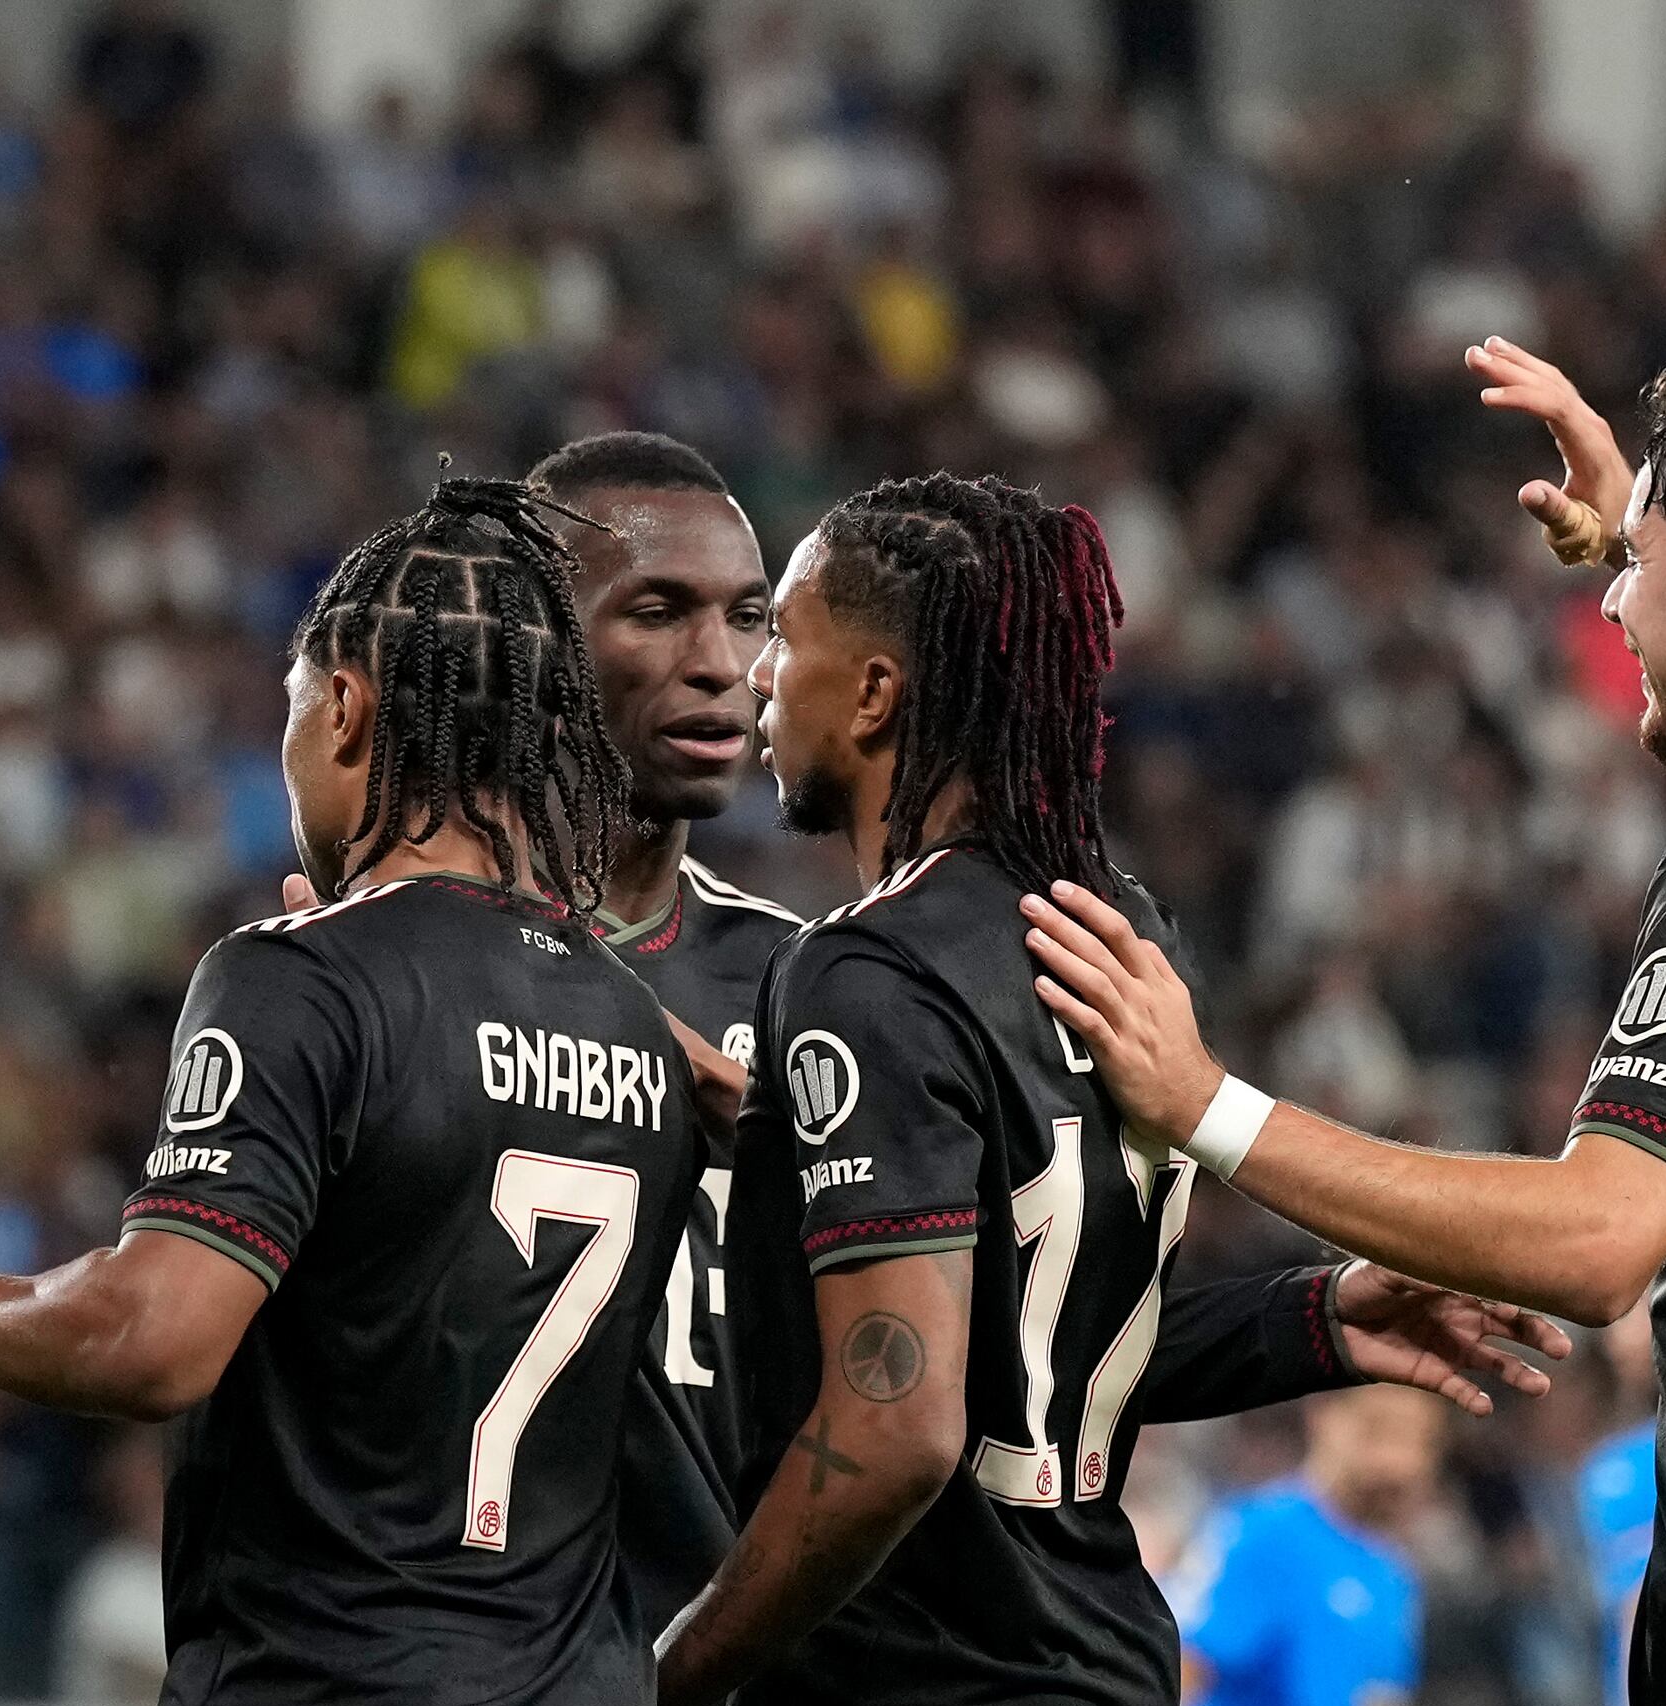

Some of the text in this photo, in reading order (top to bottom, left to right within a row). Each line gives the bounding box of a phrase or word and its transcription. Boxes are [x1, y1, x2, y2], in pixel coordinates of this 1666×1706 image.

[519, 927, 572, 956] FCBM
[476, 1021, 667, 1132] GNABRY
[460, 1149, 639, 1552] 7
[973, 1116, 1198, 1508] 17
